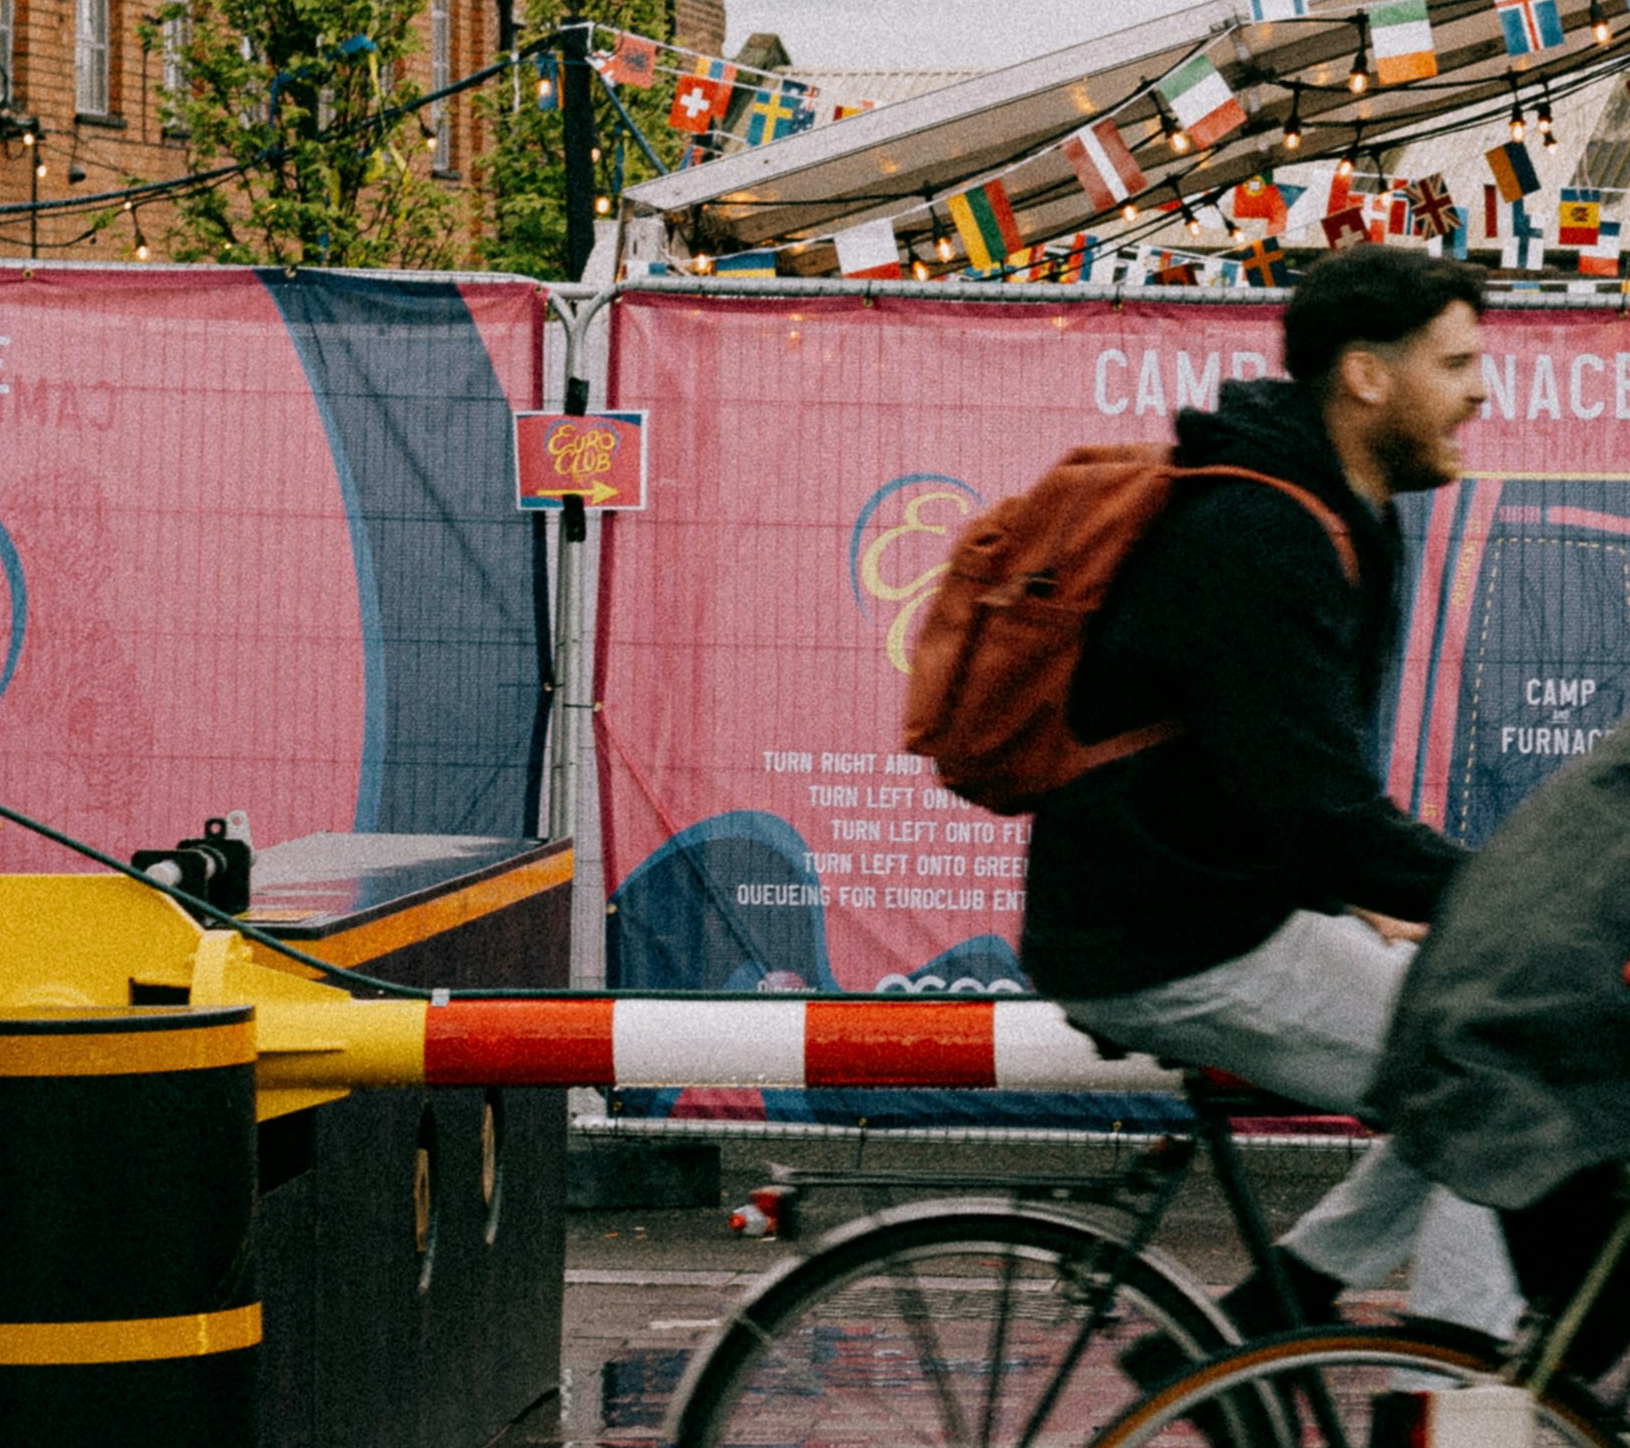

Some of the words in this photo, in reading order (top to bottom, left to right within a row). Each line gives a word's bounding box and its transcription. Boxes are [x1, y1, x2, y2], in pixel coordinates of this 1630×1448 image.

[548, 424, 616, 455] EURO
[554, 443, 611, 475] CLUB
[1526, 678, 1597, 706] CAMP
[763, 751, 812, 774] TURN
[821, 752, 877, 775] RIGHT
[884, 754, 922, 776] AND
[808, 785, 859, 808] TURN
[866, 787, 914, 809] LEFT
[831, 819, 881, 841] TURN
[888, 821, 938, 843] LEFT
[945, 822, 995, 843] ONTO
[803, 852, 852, 874] TURN
[860, 853, 908, 876] LEFT
[916, 855, 966, 877] ONTO
[736, 883, 830, 906] QUEUEING
[838, 886, 877, 908] FOR
[884, 887, 985, 910] EUROCLUB
